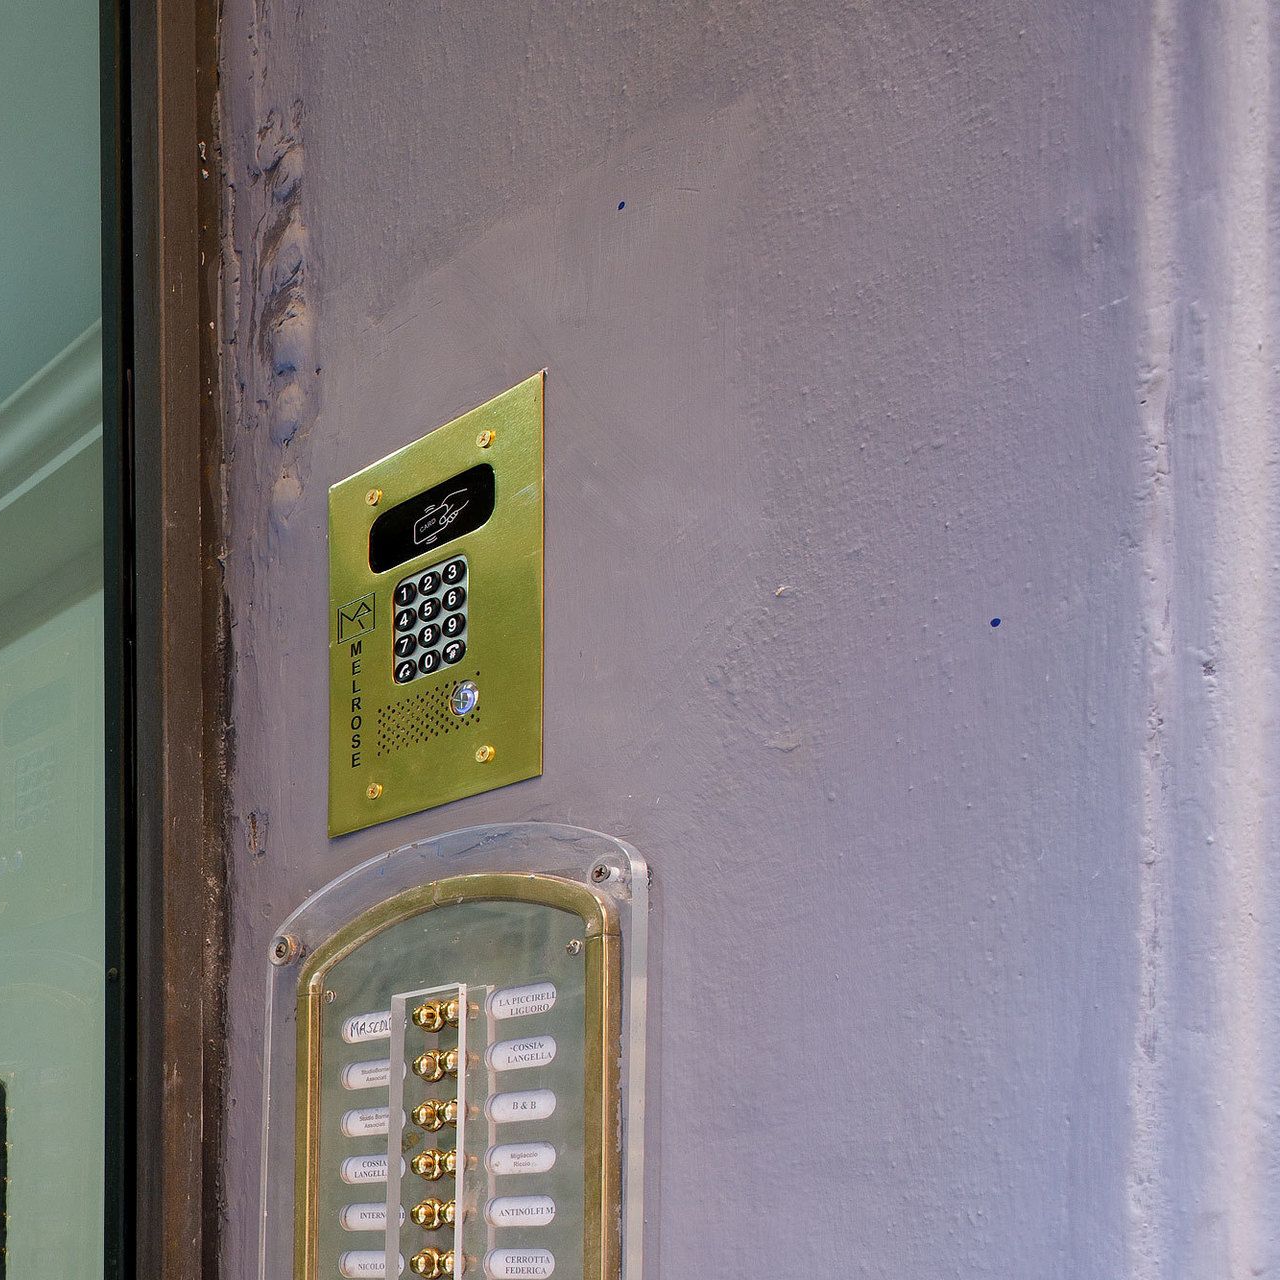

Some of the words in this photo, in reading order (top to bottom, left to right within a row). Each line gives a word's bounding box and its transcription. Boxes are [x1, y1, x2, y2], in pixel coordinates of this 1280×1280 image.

[419, 518, 437, 533] CARD
[401, 587, 408, 601] 1
[424, 576, 432, 591] 2
[448, 564, 457, 579] 3
[399, 613, 408, 627] 4
[424, 602, 432, 616] 5
[448, 590, 456, 605] 6
[400, 638, 408, 653] 7
[424, 628, 432, 642] 8
[448, 618, 457, 632] 9
[424, 654, 433, 669] 0
[350, 640, 362, 768] MELROSE
[510, 1003, 550, 1016] LIGUORO
[507, 1052, 553, 1064] LANGELLA
[512, 1101, 519, 1110] B
[520, 1101, 528, 1110] &
[530, 1101, 537, 1109] B
[505, 1256, 551, 1264] CERROTTA
[505, 1267, 547, 1275] FEDERICA
